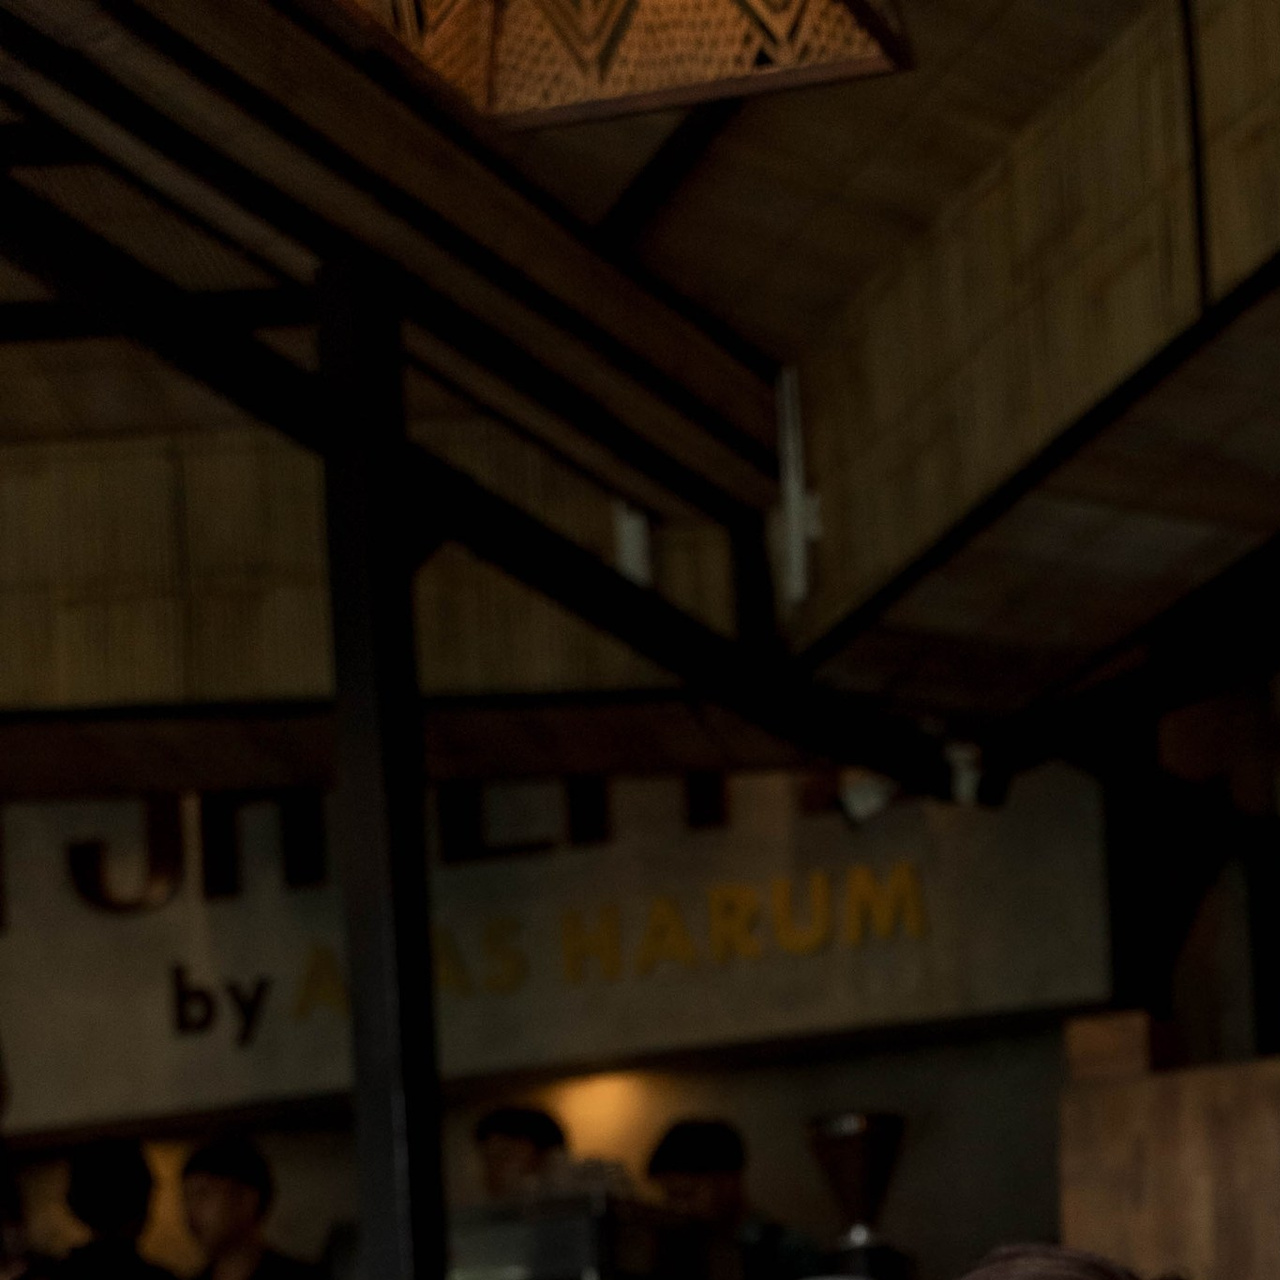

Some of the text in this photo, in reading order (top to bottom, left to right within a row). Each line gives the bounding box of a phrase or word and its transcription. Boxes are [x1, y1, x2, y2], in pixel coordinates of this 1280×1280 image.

[175, 860, 925, 1047] by AAS HARUM
